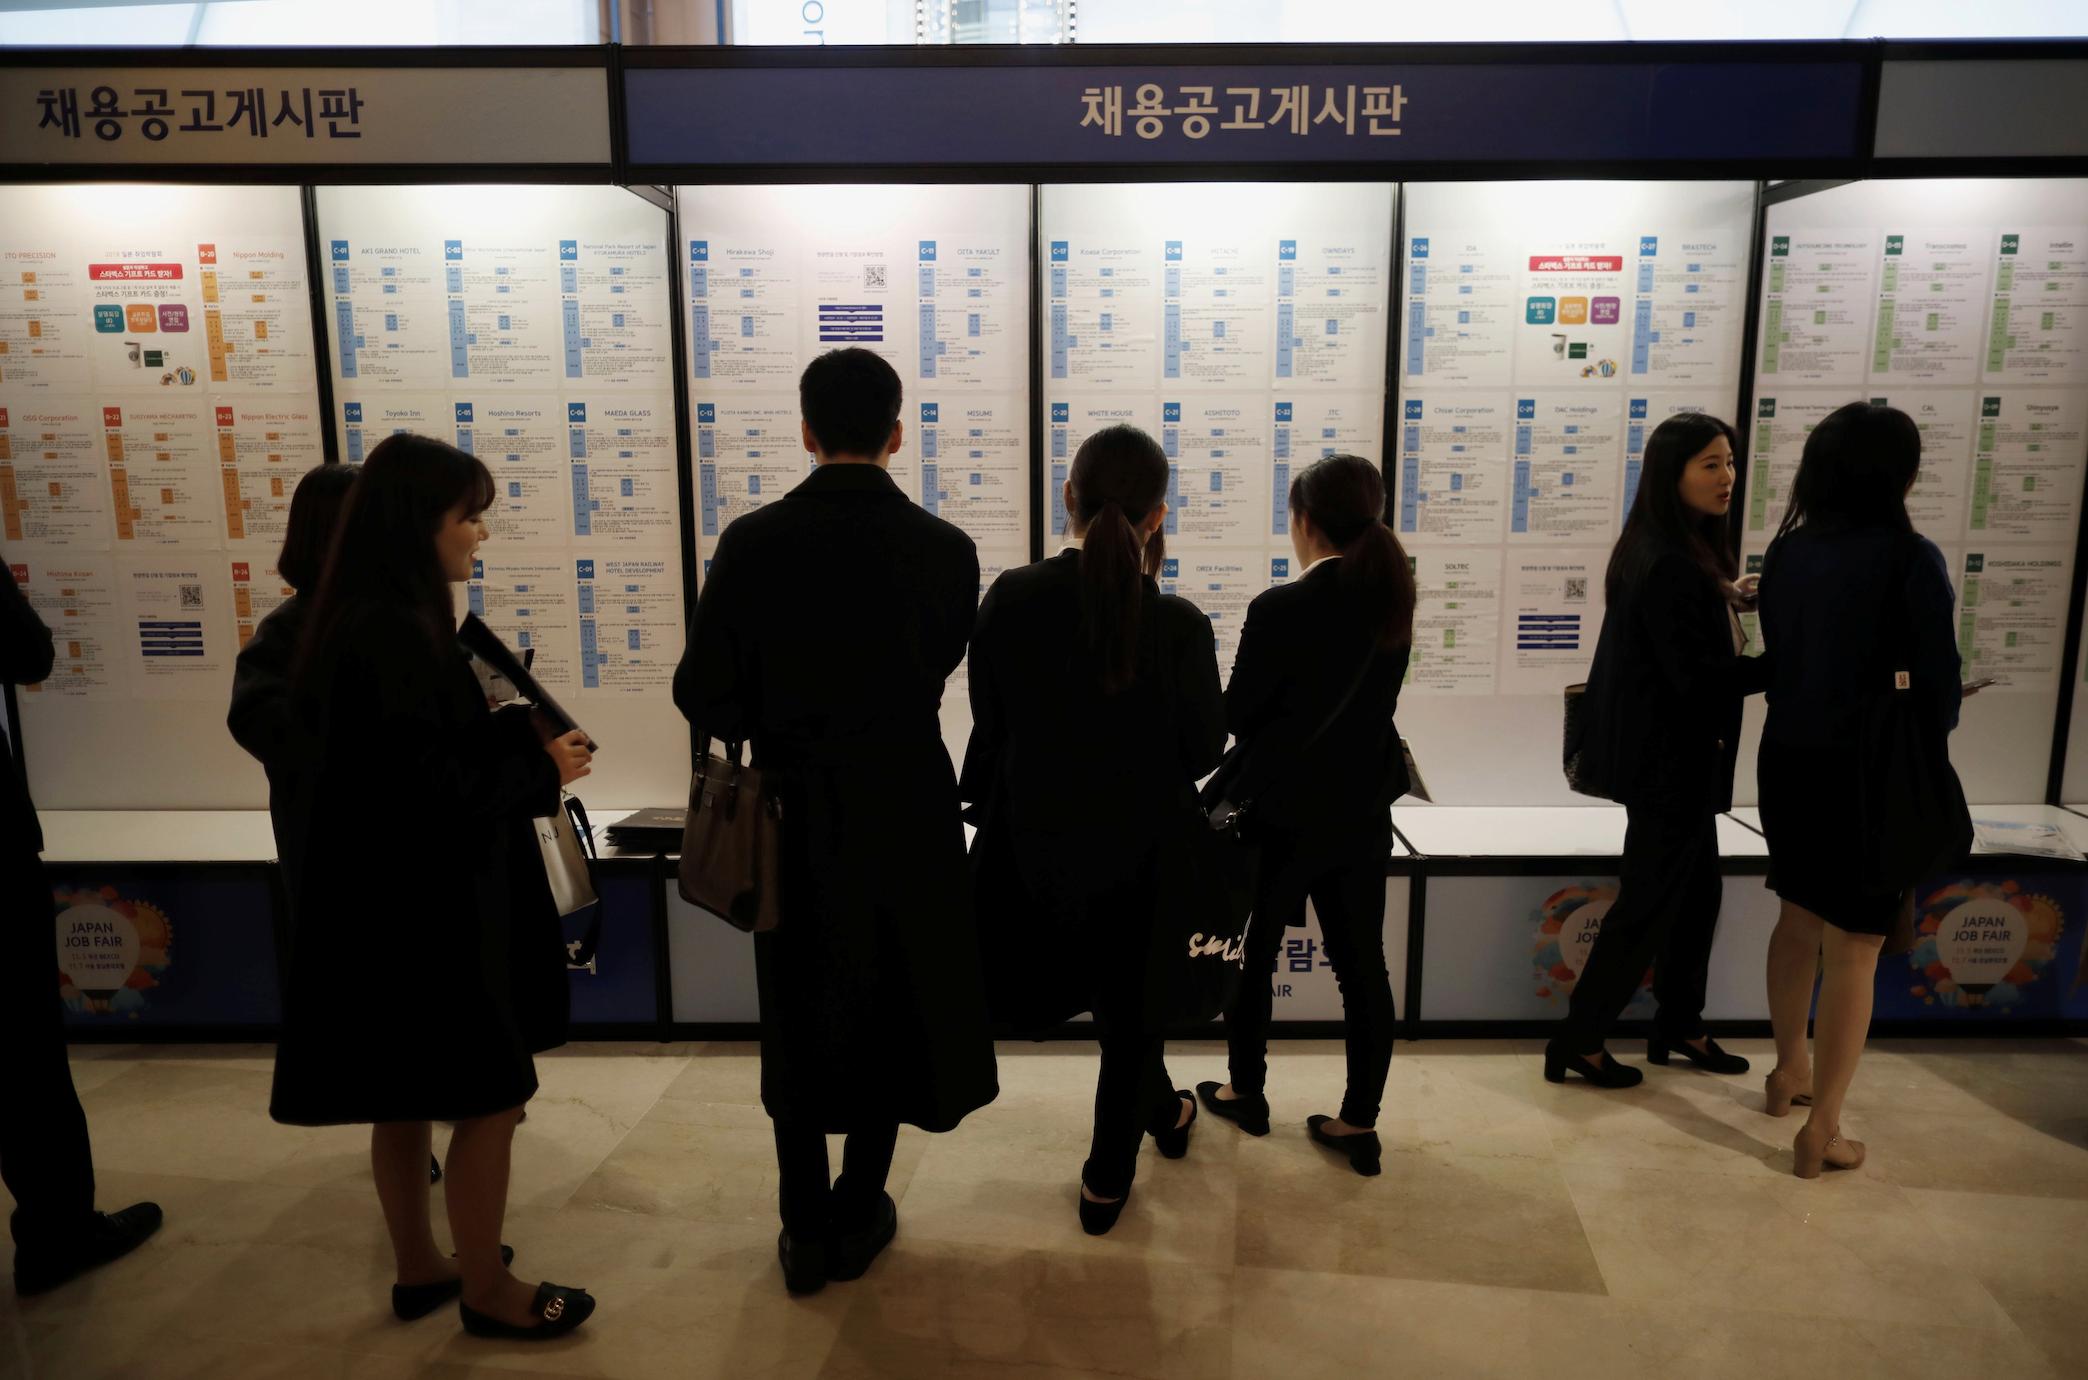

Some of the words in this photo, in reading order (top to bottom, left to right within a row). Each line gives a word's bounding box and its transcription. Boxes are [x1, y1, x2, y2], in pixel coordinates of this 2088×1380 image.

[37, 86, 363, 141] 채용공고게시판
[1080, 83, 1408, 139] 채용공고게시판
[233, 251, 257, 259] Nippon
[258, 251, 284, 259] Molding
[374, 247, 398, 255] GRAND
[399, 247, 421, 255] HOTEL
[1569, 406, 1598, 414] Holdings
[71, 922, 113, 934] JAPAN
[1962, 917, 2005, 928] JAPAN
[65, 936, 89, 948] JOB
[94, 936, 123, 948] FAIR
[1952, 930, 1978, 942] JOB
[1982, 930, 2011, 942] FAIR
